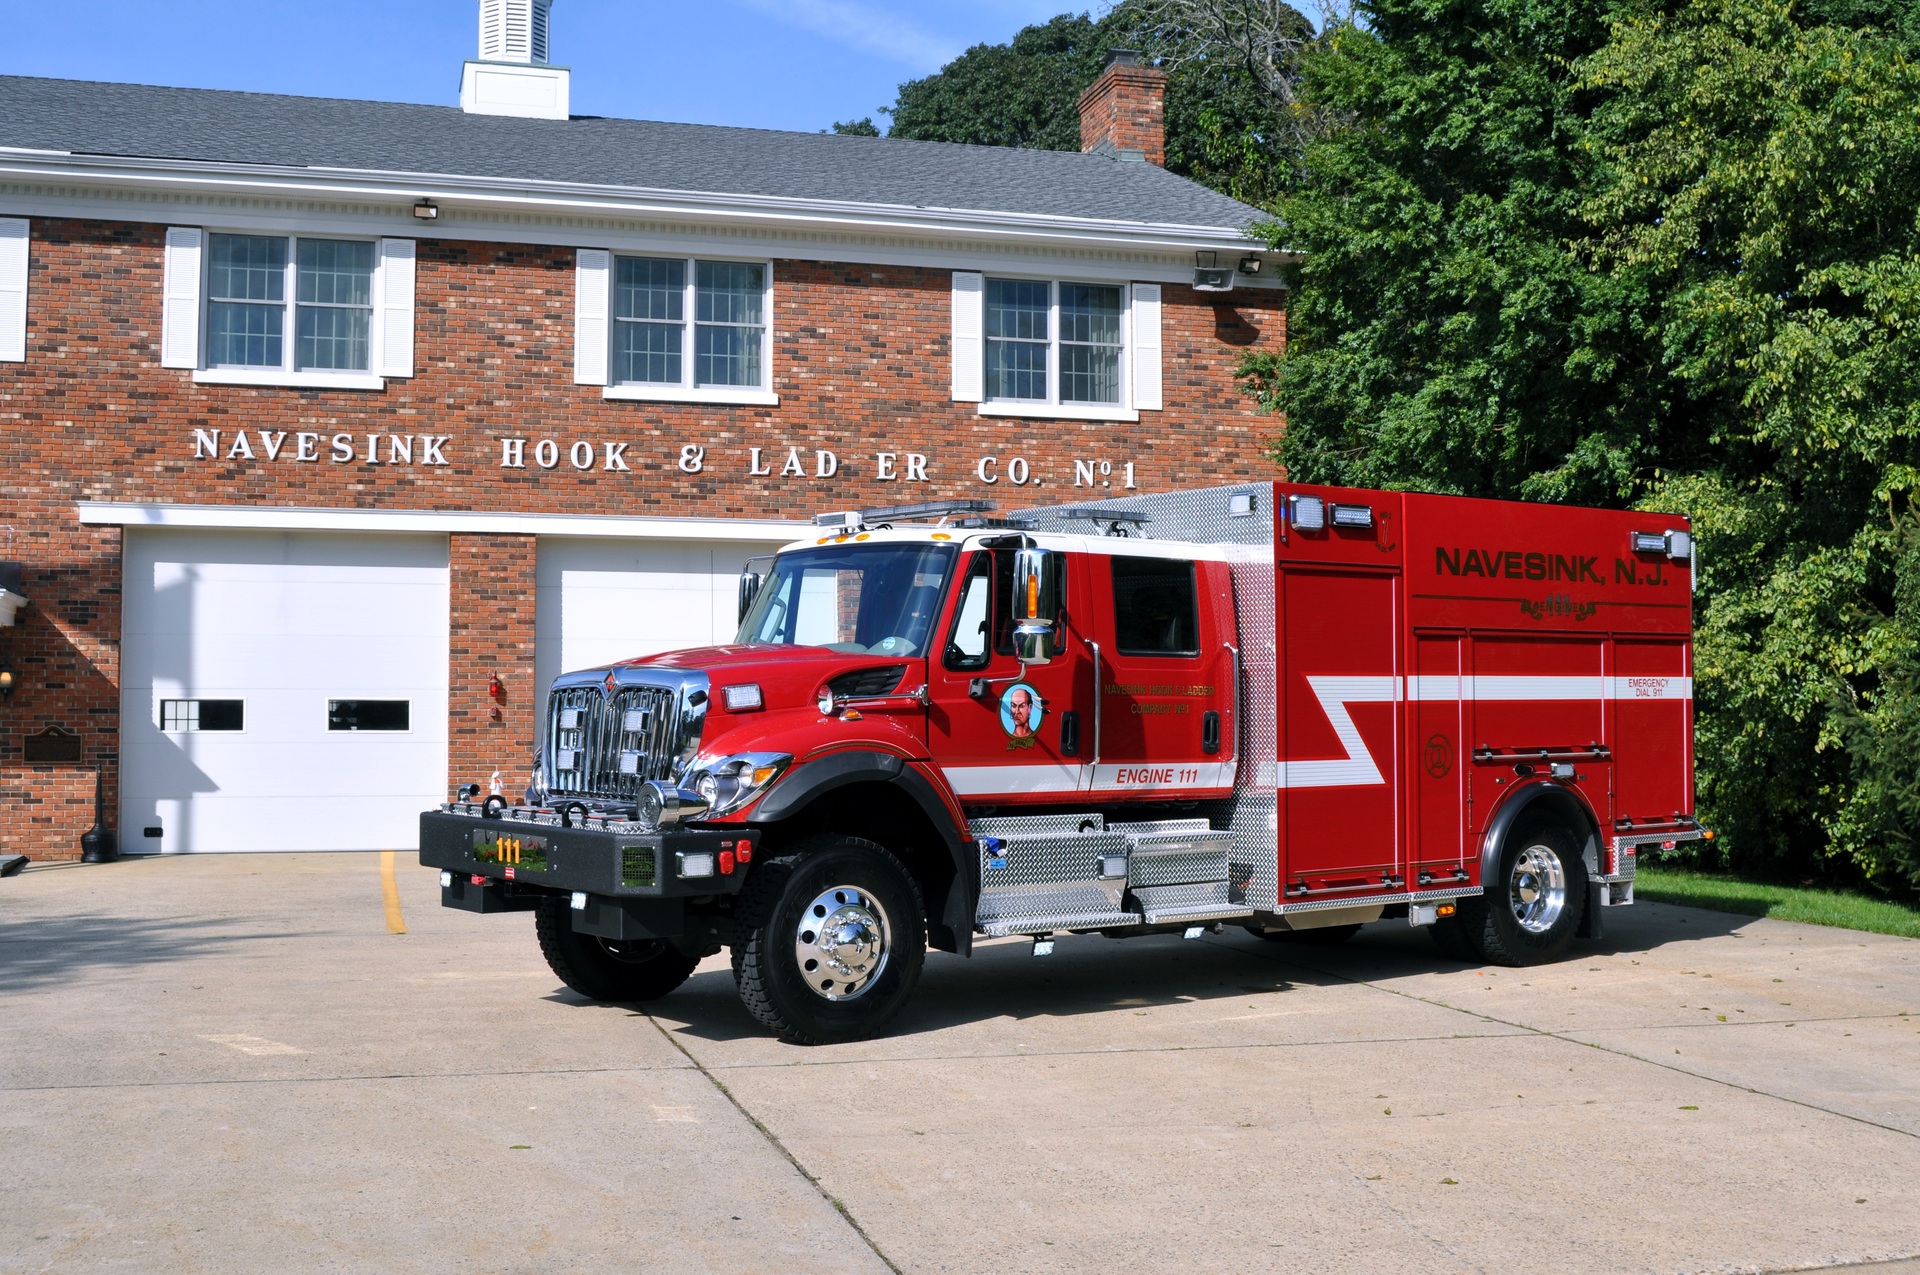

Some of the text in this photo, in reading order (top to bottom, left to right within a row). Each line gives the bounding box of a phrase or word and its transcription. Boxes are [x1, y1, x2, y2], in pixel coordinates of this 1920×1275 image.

[194, 428, 449, 467] NAVESINK
[500, 438, 631, 472] HOOK
[678, 445, 704, 474] &
[977, 456, 1041, 485] CO.
[1435, 547, 1668, 586] NAVESINK, N.J.
[1104, 684, 1147, 695] NAVESINK
[1149, 685, 1174, 696] HOOK
[1182, 685, 1215, 696] LADDER
[1628, 678, 1669, 688] EMERGENCY
[1636, 688, 1663, 697] DIAL 911
[1131, 703, 1171, 714] COMPANY
[1116, 768, 1198, 784] ENGINE 111
[496, 836, 520, 864] 111
